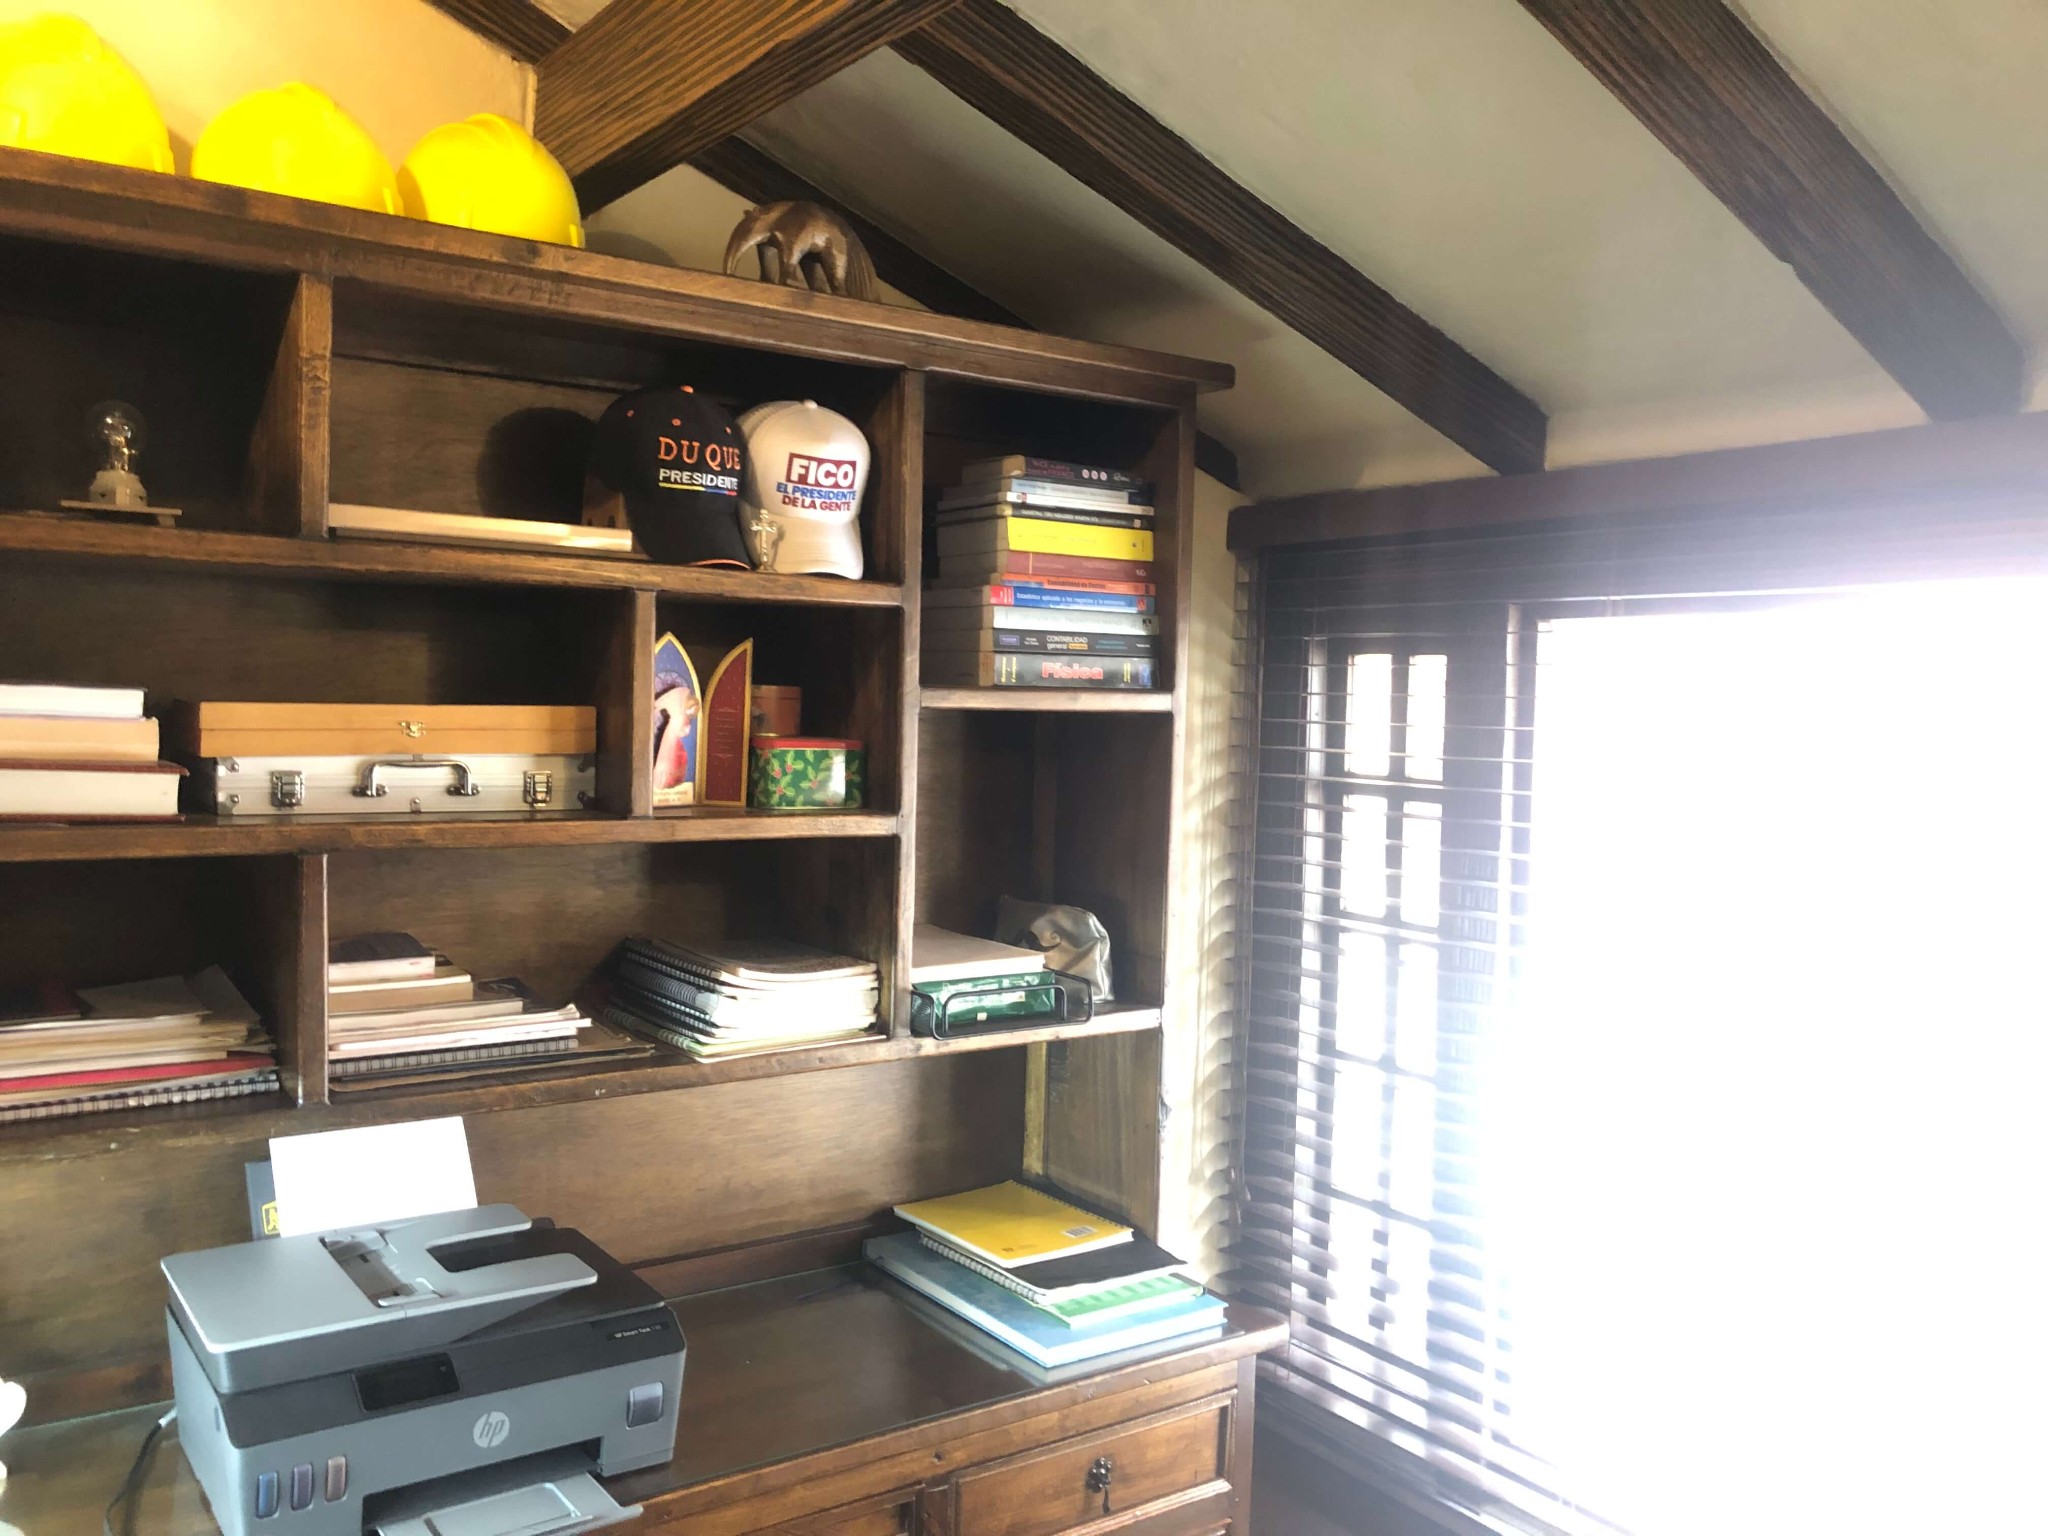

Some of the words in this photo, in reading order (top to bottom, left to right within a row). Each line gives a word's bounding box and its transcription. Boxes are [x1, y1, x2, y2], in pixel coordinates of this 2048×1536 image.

[658, 437, 741, 471] DUQUE
[659, 468, 738, 490] PRESIDENTE
[790, 457, 853, 488] FICO
[776, 482, 789, 495] EL
[791, 485, 856, 501] PRESIDENTE
[782, 495, 800, 507] DE
[801, 498, 817, 510] LA
[820, 501, 852, 512] GENTE
[1046, 635, 1089, 643] CONTABILIDAD
[478, 1411, 506, 1449] hp
